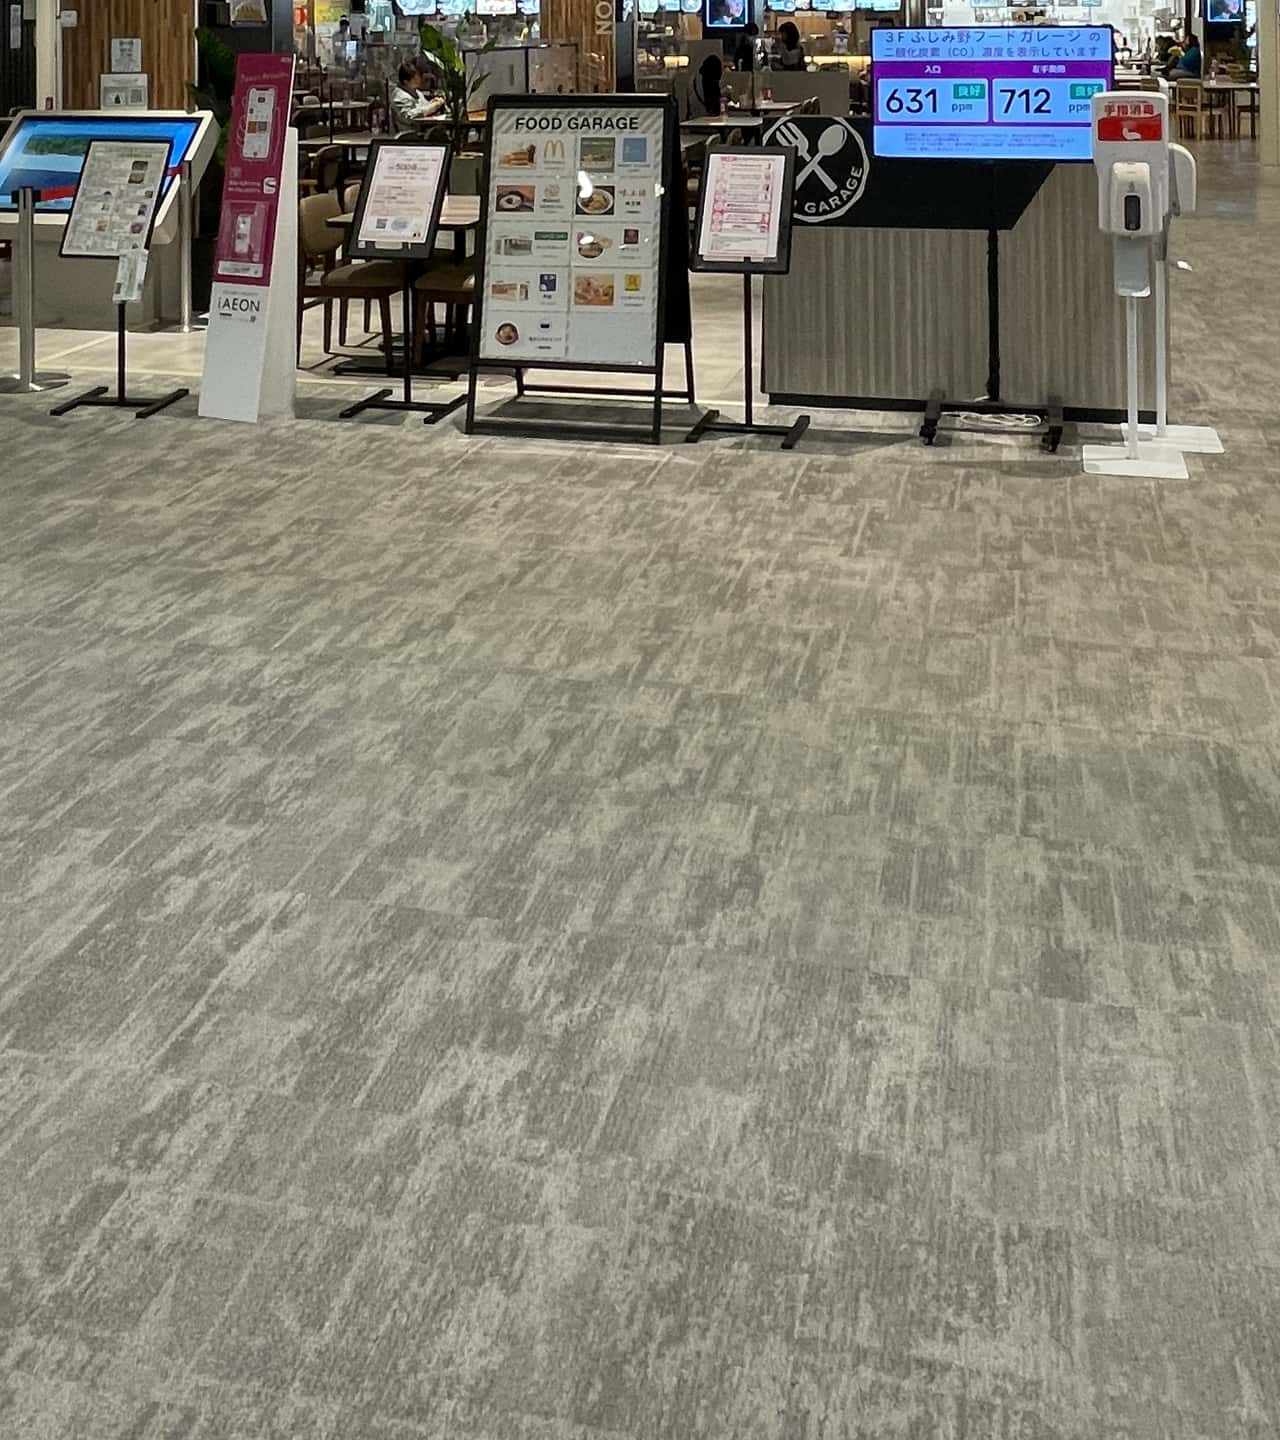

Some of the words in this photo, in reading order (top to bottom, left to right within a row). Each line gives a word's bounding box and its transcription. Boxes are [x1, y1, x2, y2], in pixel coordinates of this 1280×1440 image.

[958, 84, 984, 96] 良好
[886, 88, 939, 113] 631
[952, 103, 973, 113] ppm
[1000, 88, 1052, 113] 712
[515, 116, 562, 130] FOOD
[567, 116, 639, 130] GARAGE
[804, 166, 863, 213] GARAGE
